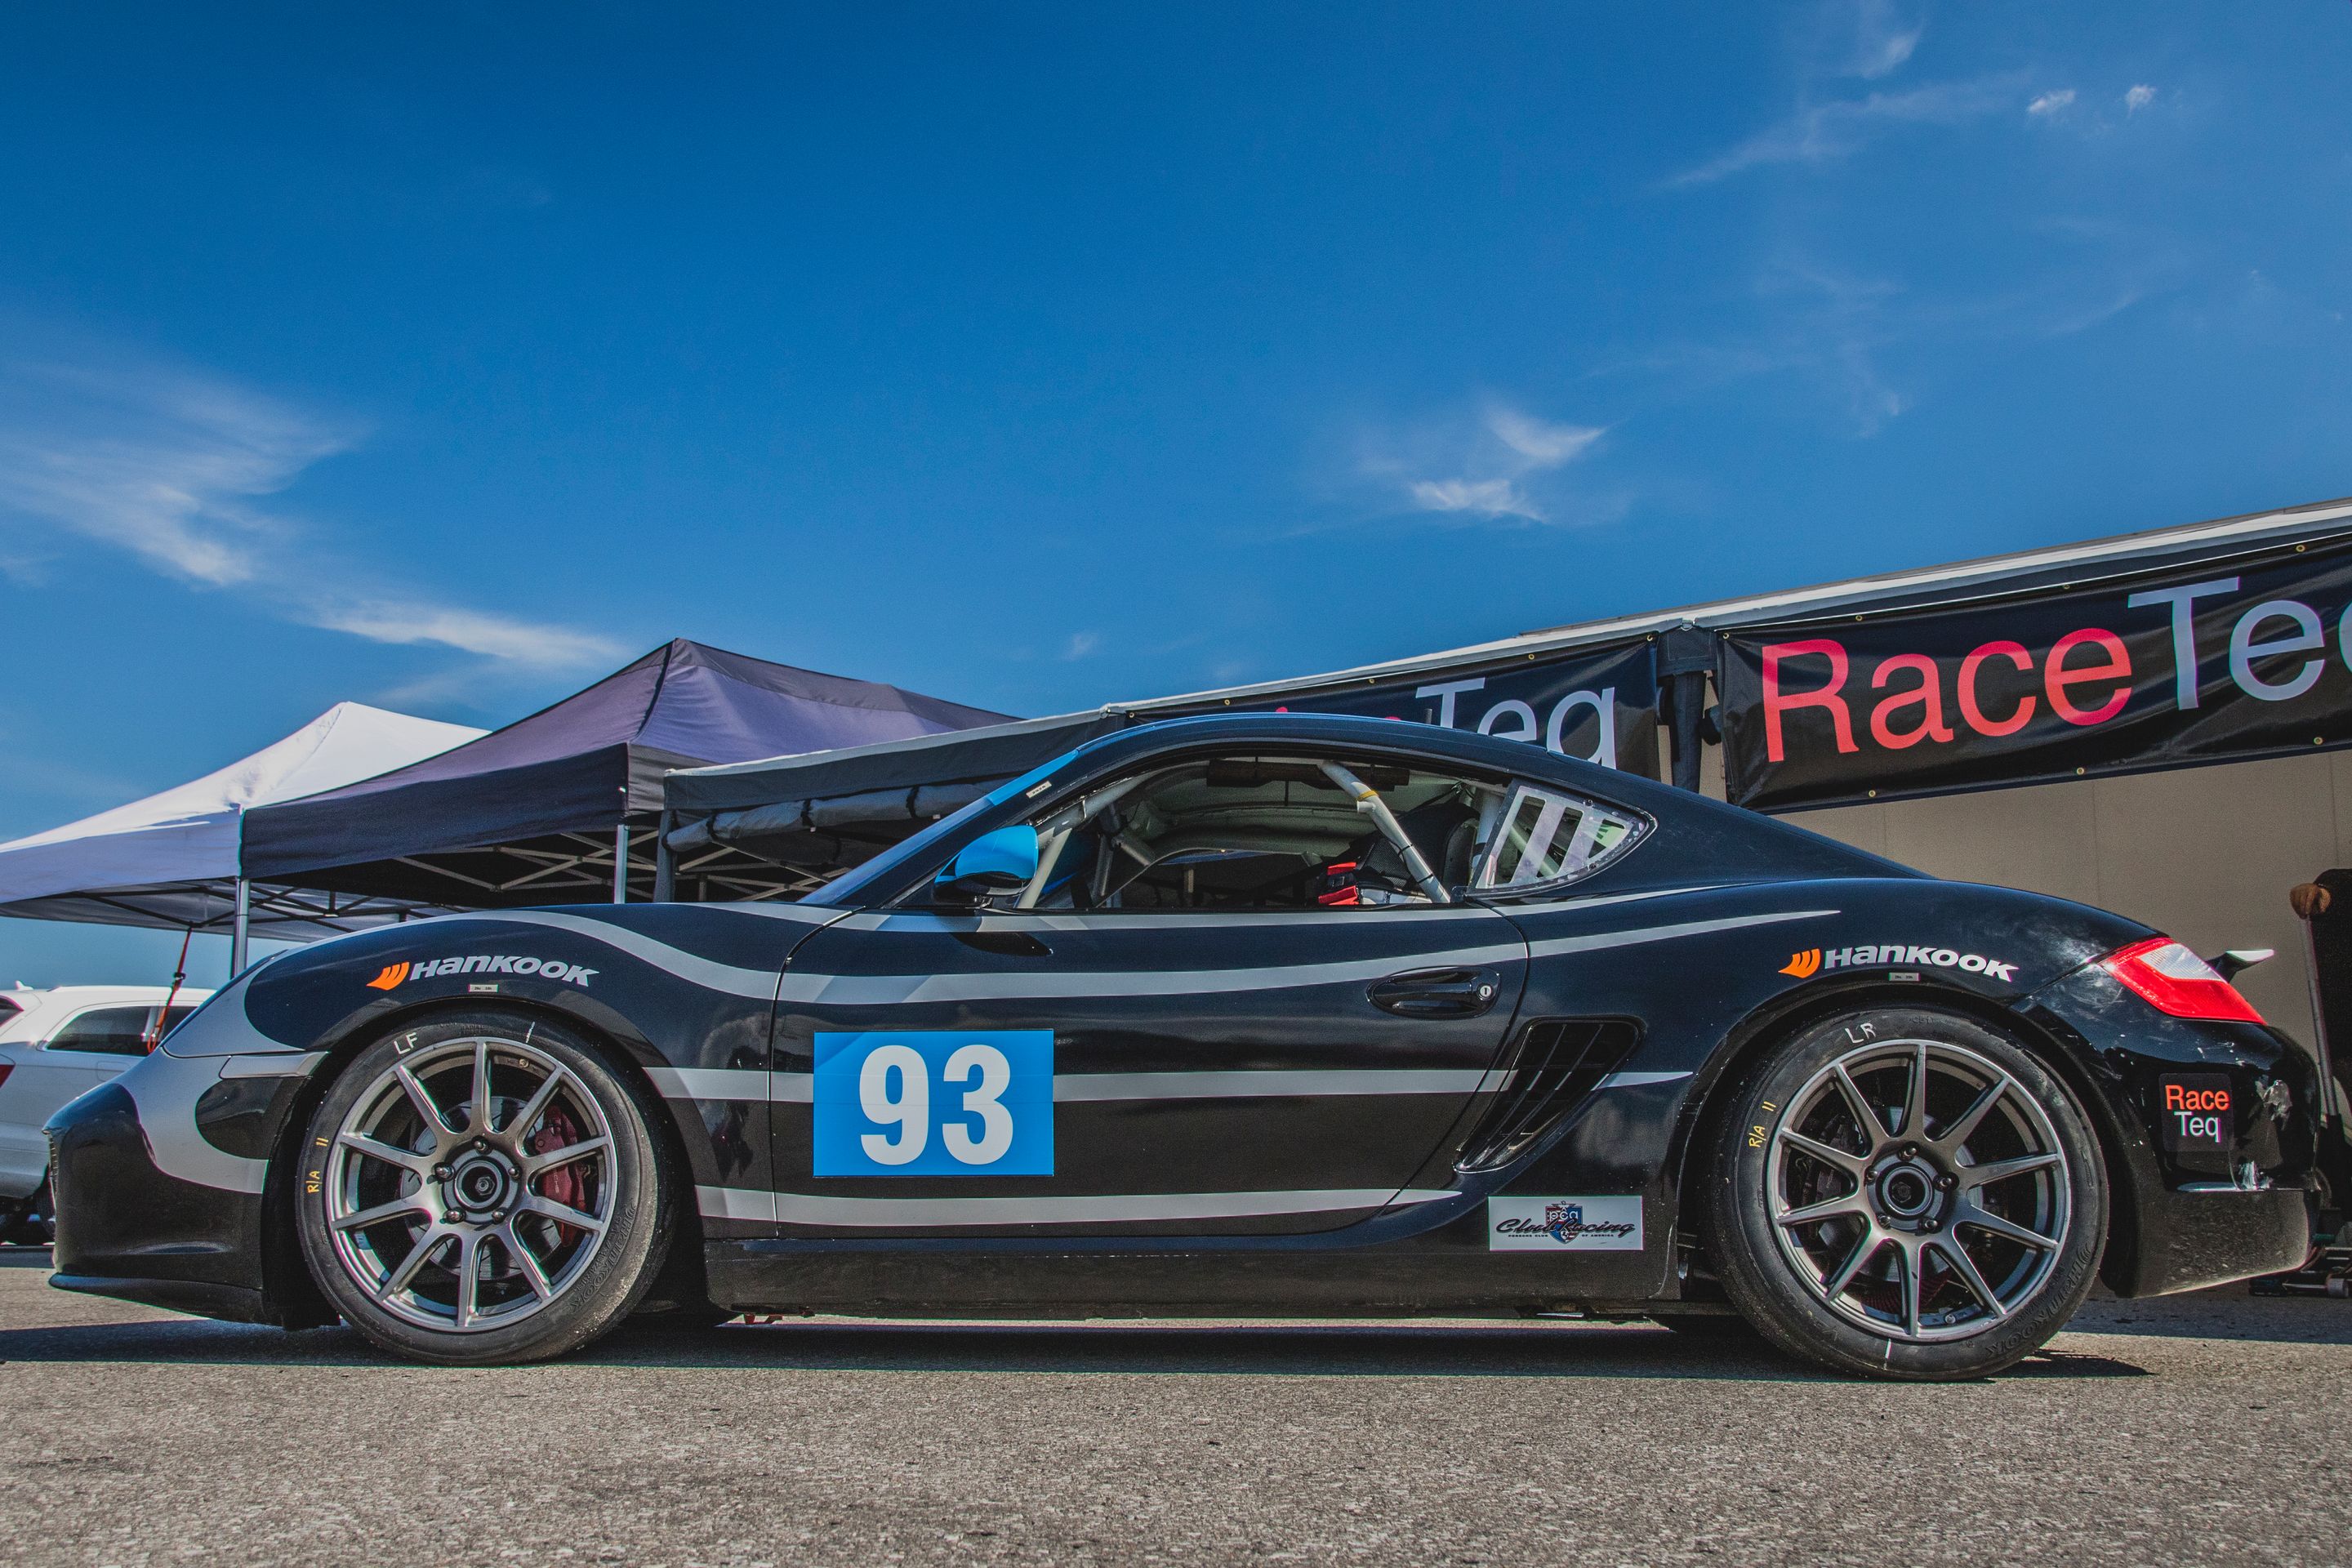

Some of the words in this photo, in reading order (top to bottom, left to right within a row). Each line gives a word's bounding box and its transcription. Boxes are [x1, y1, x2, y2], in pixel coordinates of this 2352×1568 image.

[1762, 576, 2352, 763] RaceTe
[393, 1032, 418, 1054] LF
[1845, 1022, 1876, 1044] LR
[859, 1044, 1013, 1165] 93
[2165, 1085, 2230, 1111] Race
[2174, 1111, 2221, 1143] Teq
[1496, 1218, 1556, 1234] Club
[1556, 1218, 1636, 1238] Racing
[1549, 1210, 1579, 1222] pca
